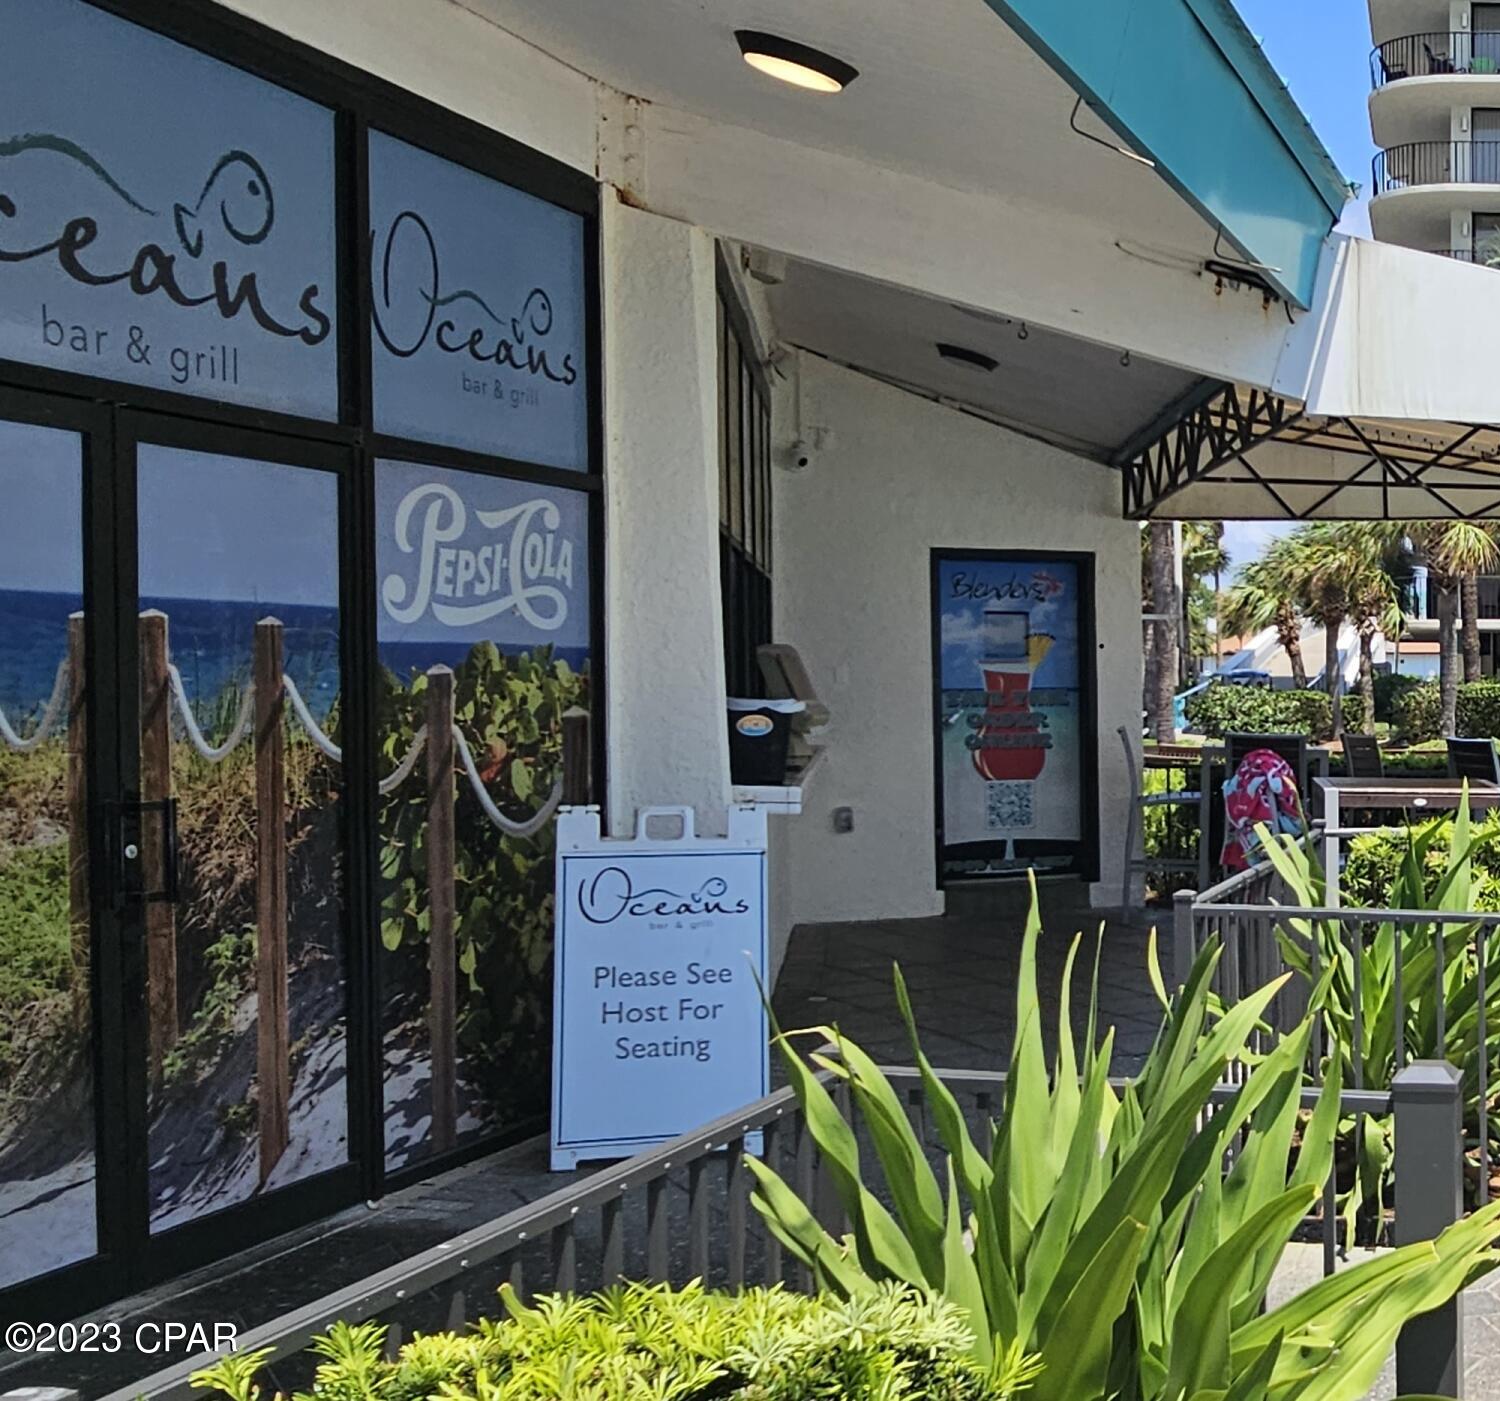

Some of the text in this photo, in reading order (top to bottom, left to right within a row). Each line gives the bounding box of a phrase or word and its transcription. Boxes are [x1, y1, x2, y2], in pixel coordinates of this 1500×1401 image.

[371, 211, 577, 386] Oceans
[42, 304, 238, 385] bar & grill
[462, 370, 539, 409] bar & grill
[951, 571, 1046, 603] Blenders
[578, 866, 749, 924] Oceans
[594, 962, 733, 989] Please See
[601, 998, 724, 1025] Host For
[615, 1035, 711, 1063] Seating
